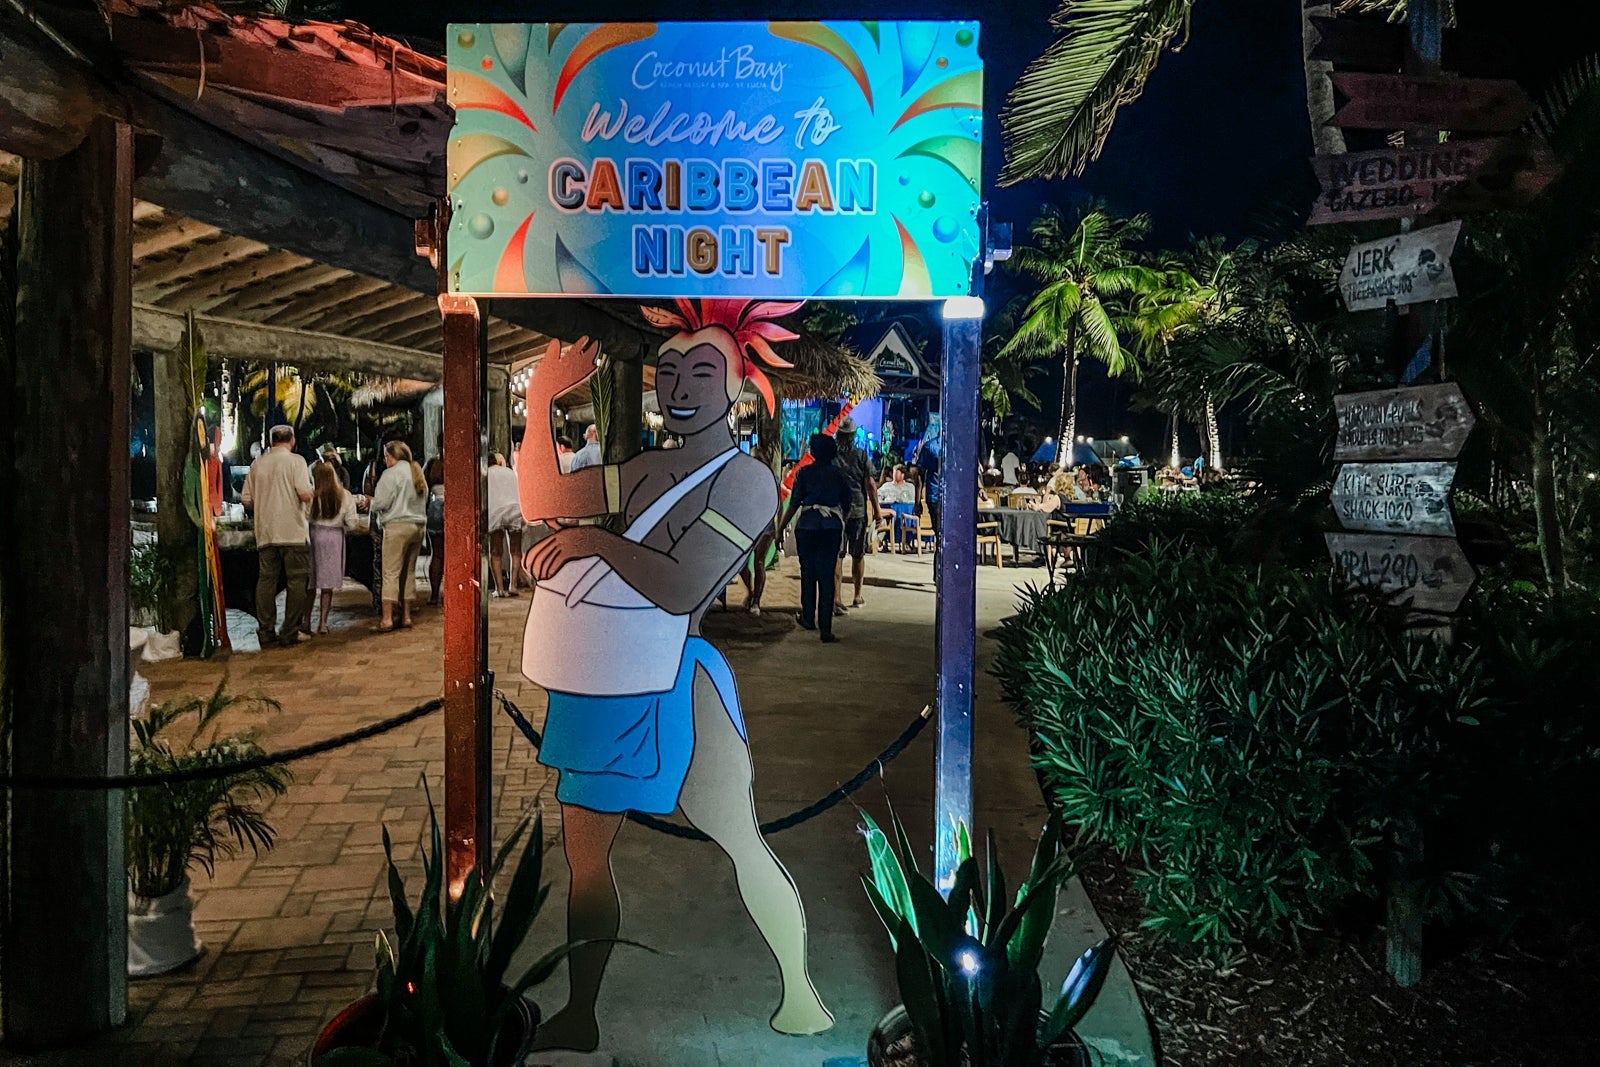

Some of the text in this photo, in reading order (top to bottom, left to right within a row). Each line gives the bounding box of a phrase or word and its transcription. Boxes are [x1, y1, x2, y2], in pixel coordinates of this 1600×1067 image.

[631, 44, 787, 92] Coconut Bay
[580, 95, 842, 149] Welcome to
[549, 157, 876, 215] CARIBBEAN
[1328, 147, 1474, 188] WEDDING
[631, 225, 792, 279] NIGHT
[1352, 244, 1396, 278] JERK
[1343, 473, 1414, 498] KITE SURF
[1343, 499, 1413, 522] SHACK-1020
